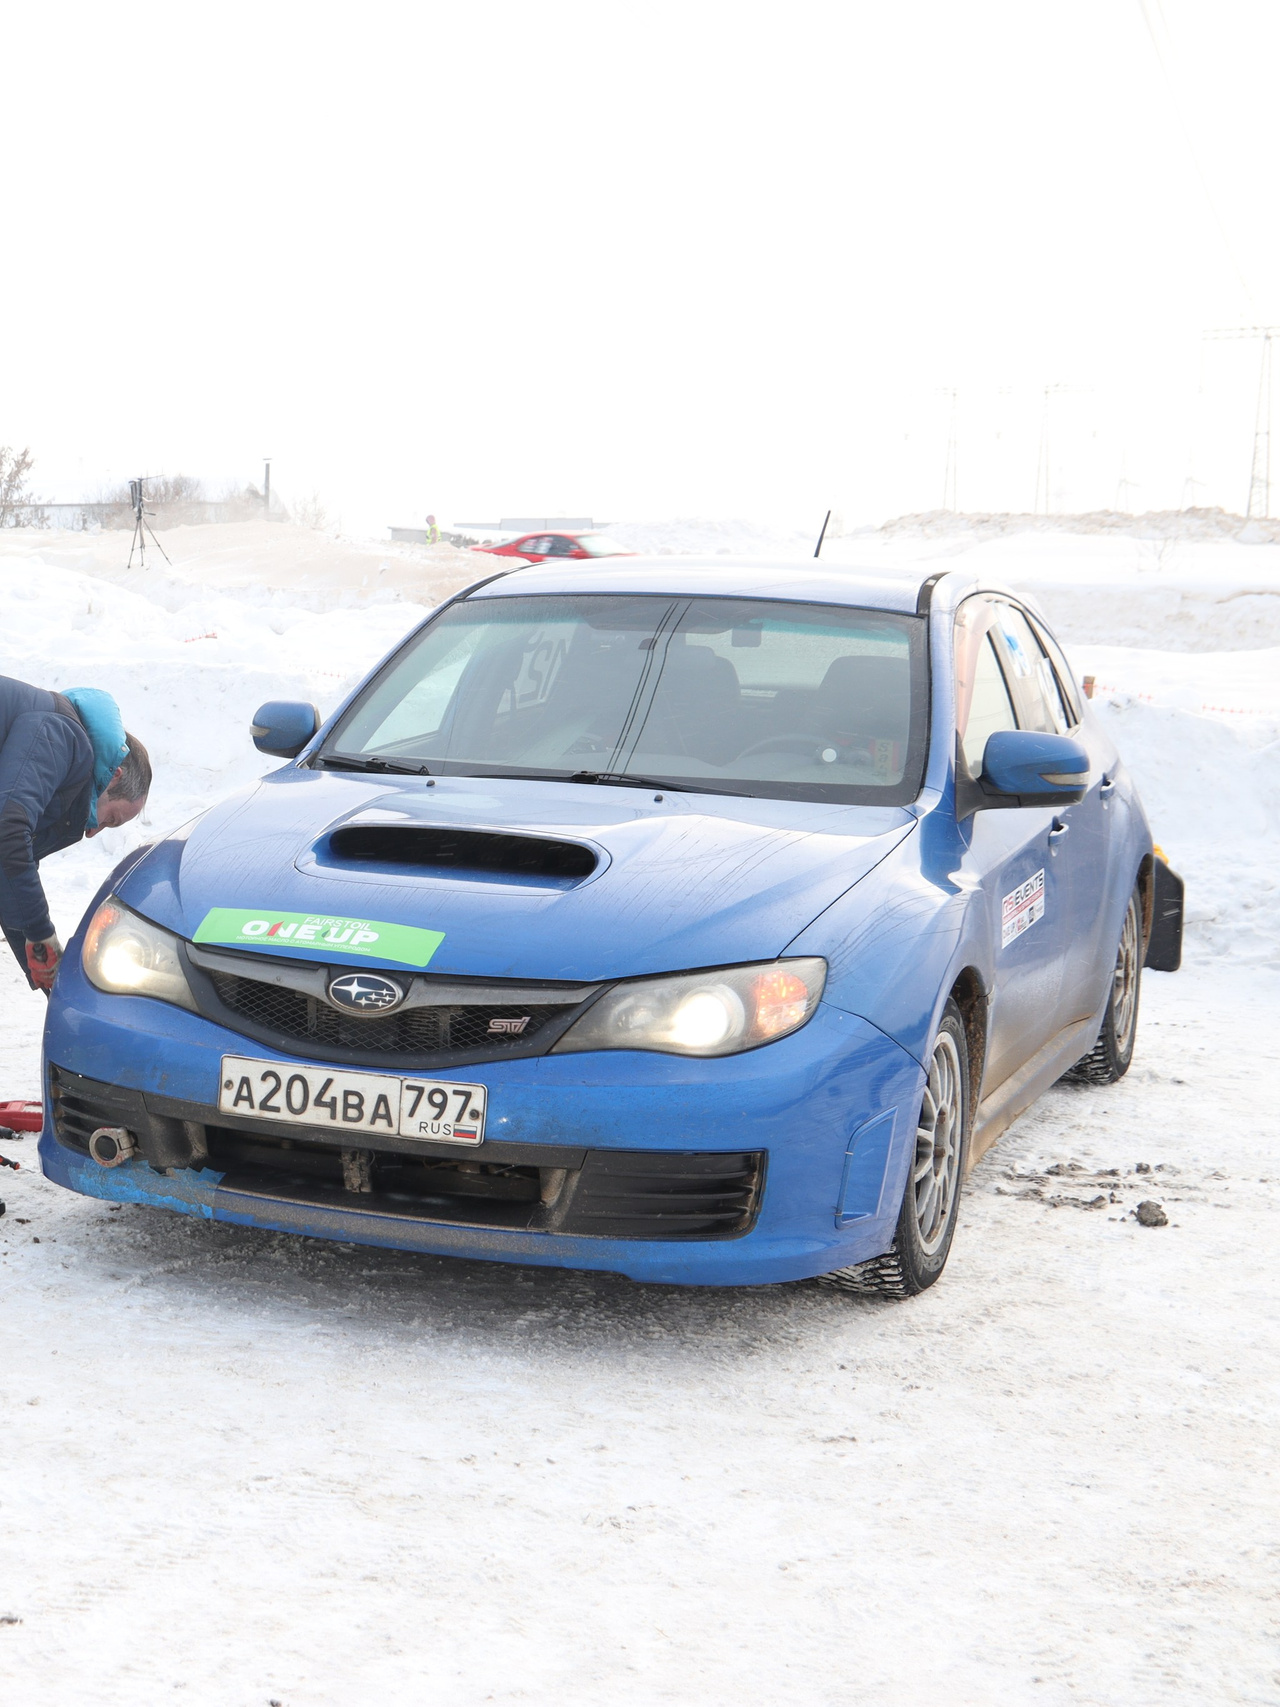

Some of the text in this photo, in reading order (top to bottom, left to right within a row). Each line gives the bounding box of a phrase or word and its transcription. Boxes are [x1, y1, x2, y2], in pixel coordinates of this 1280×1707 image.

[242, 920, 380, 945] ONE UP
[304, 917, 372, 931] FAIRSTOIL
[232, 1070, 472, 1128] А204ВА 797
[419, 1121, 451, 1136] RUS
